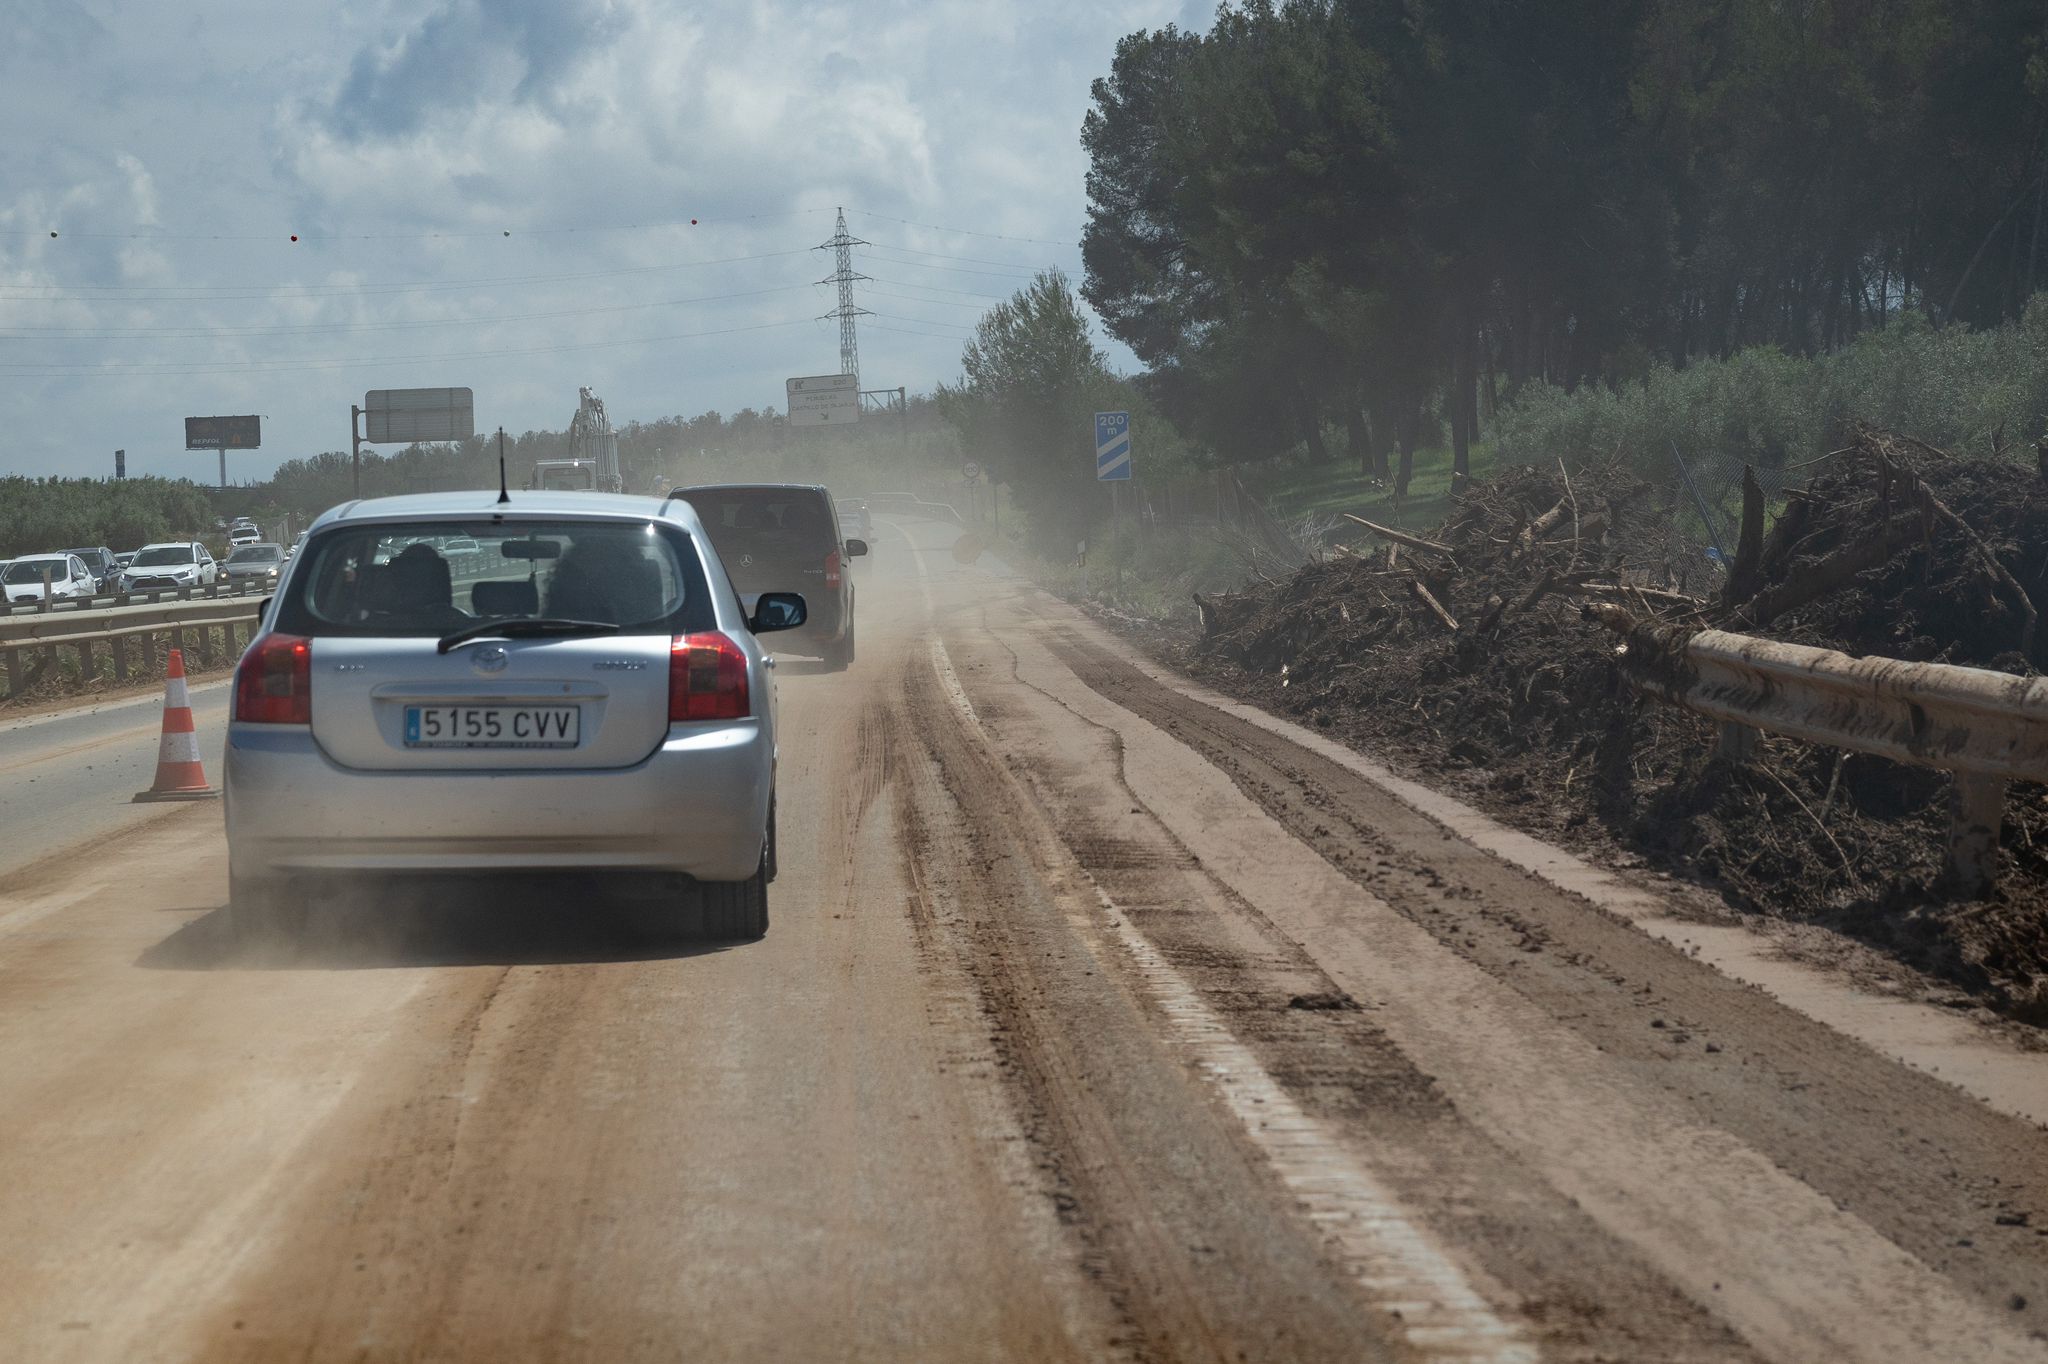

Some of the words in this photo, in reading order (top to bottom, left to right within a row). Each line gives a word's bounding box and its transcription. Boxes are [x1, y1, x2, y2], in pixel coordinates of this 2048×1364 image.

[1100, 415, 1125, 426] 200
[1107, 427, 1117, 435] m
[425, 709, 502, 738] 5155
[513, 711, 570, 738] CVV
